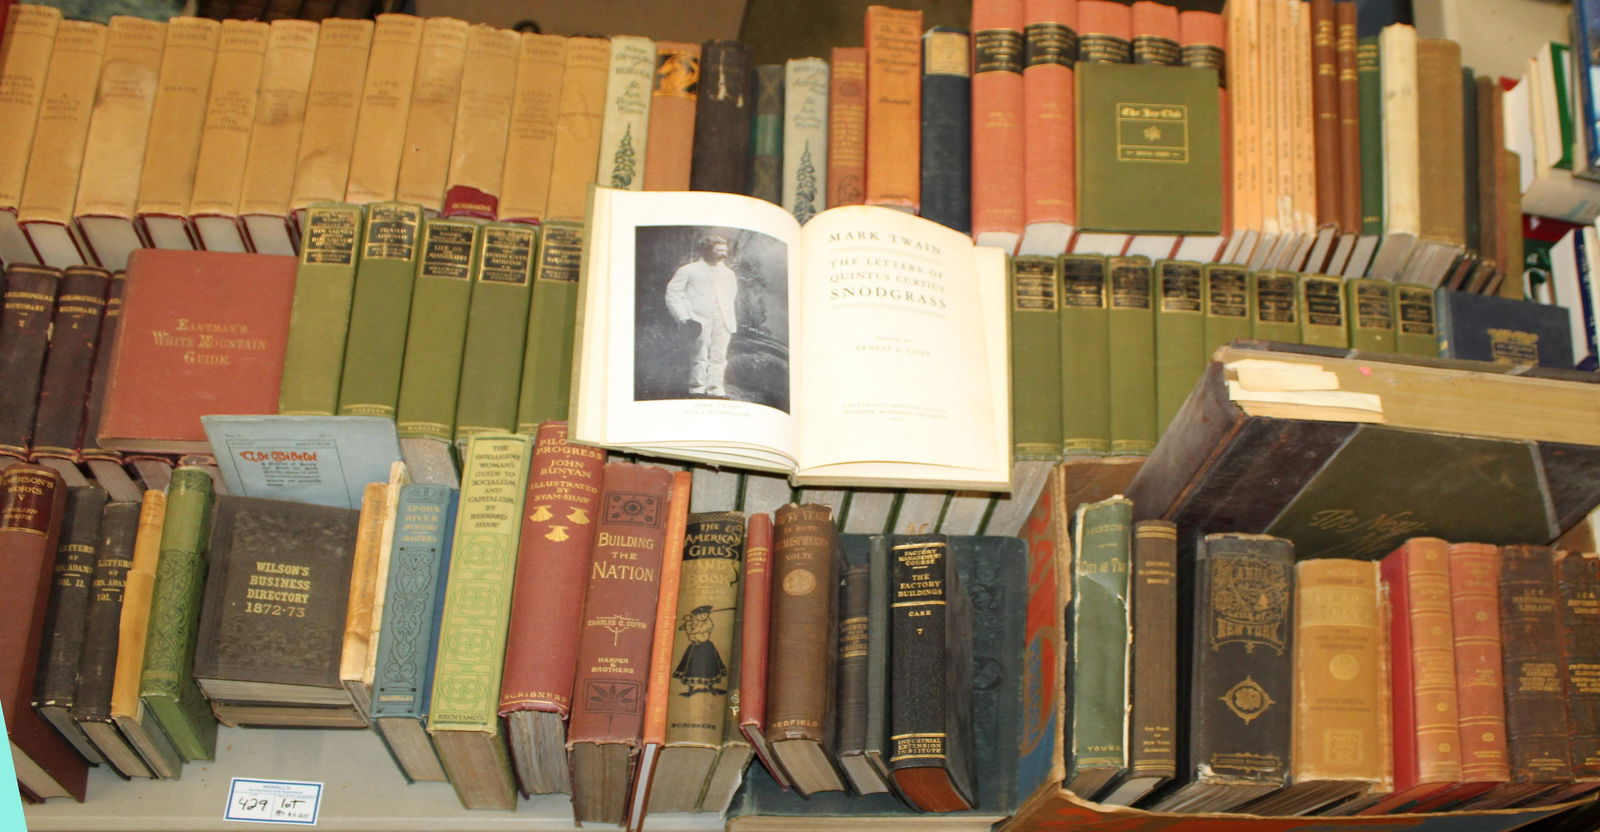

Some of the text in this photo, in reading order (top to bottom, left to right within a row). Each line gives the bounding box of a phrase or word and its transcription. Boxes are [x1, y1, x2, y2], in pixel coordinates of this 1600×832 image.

[829, 230, 942, 255] MARK TWAIN
[829, 257, 945, 280] THE LETTERS OF
[829, 271, 946, 294] QUINTUS CURTIUS
[829, 286, 948, 310] SNODGRASS
[153, 330, 267, 350] WHITE MOUNTAIN
[536, 445, 602, 460] PROGRESS
[549, 459, 585, 468] JOHN
[540, 467, 592, 478] BUNYAN
[530, 480, 598, 494] ILLUSTRATED
[700, 523, 720, 532] THE
[598, 532, 654, 550] BUILDING
[685, 533, 742, 547] AMERICAN
[611, 551, 637, 560] THE
[689, 545, 733, 558] GIRL'S
[98, 559, 133, 568] LETTERS
[256, 561, 310, 576] WILSON'S
[592, 560, 654, 582] NATION
[249, 575, 310, 590] BUSINESS
[900, 581, 941, 589] FACTORY
[246, 588, 309, 604] DIRECTORY
[898, 589, 943, 597] BUILDINGS
[238, 796, 268, 812] 429
